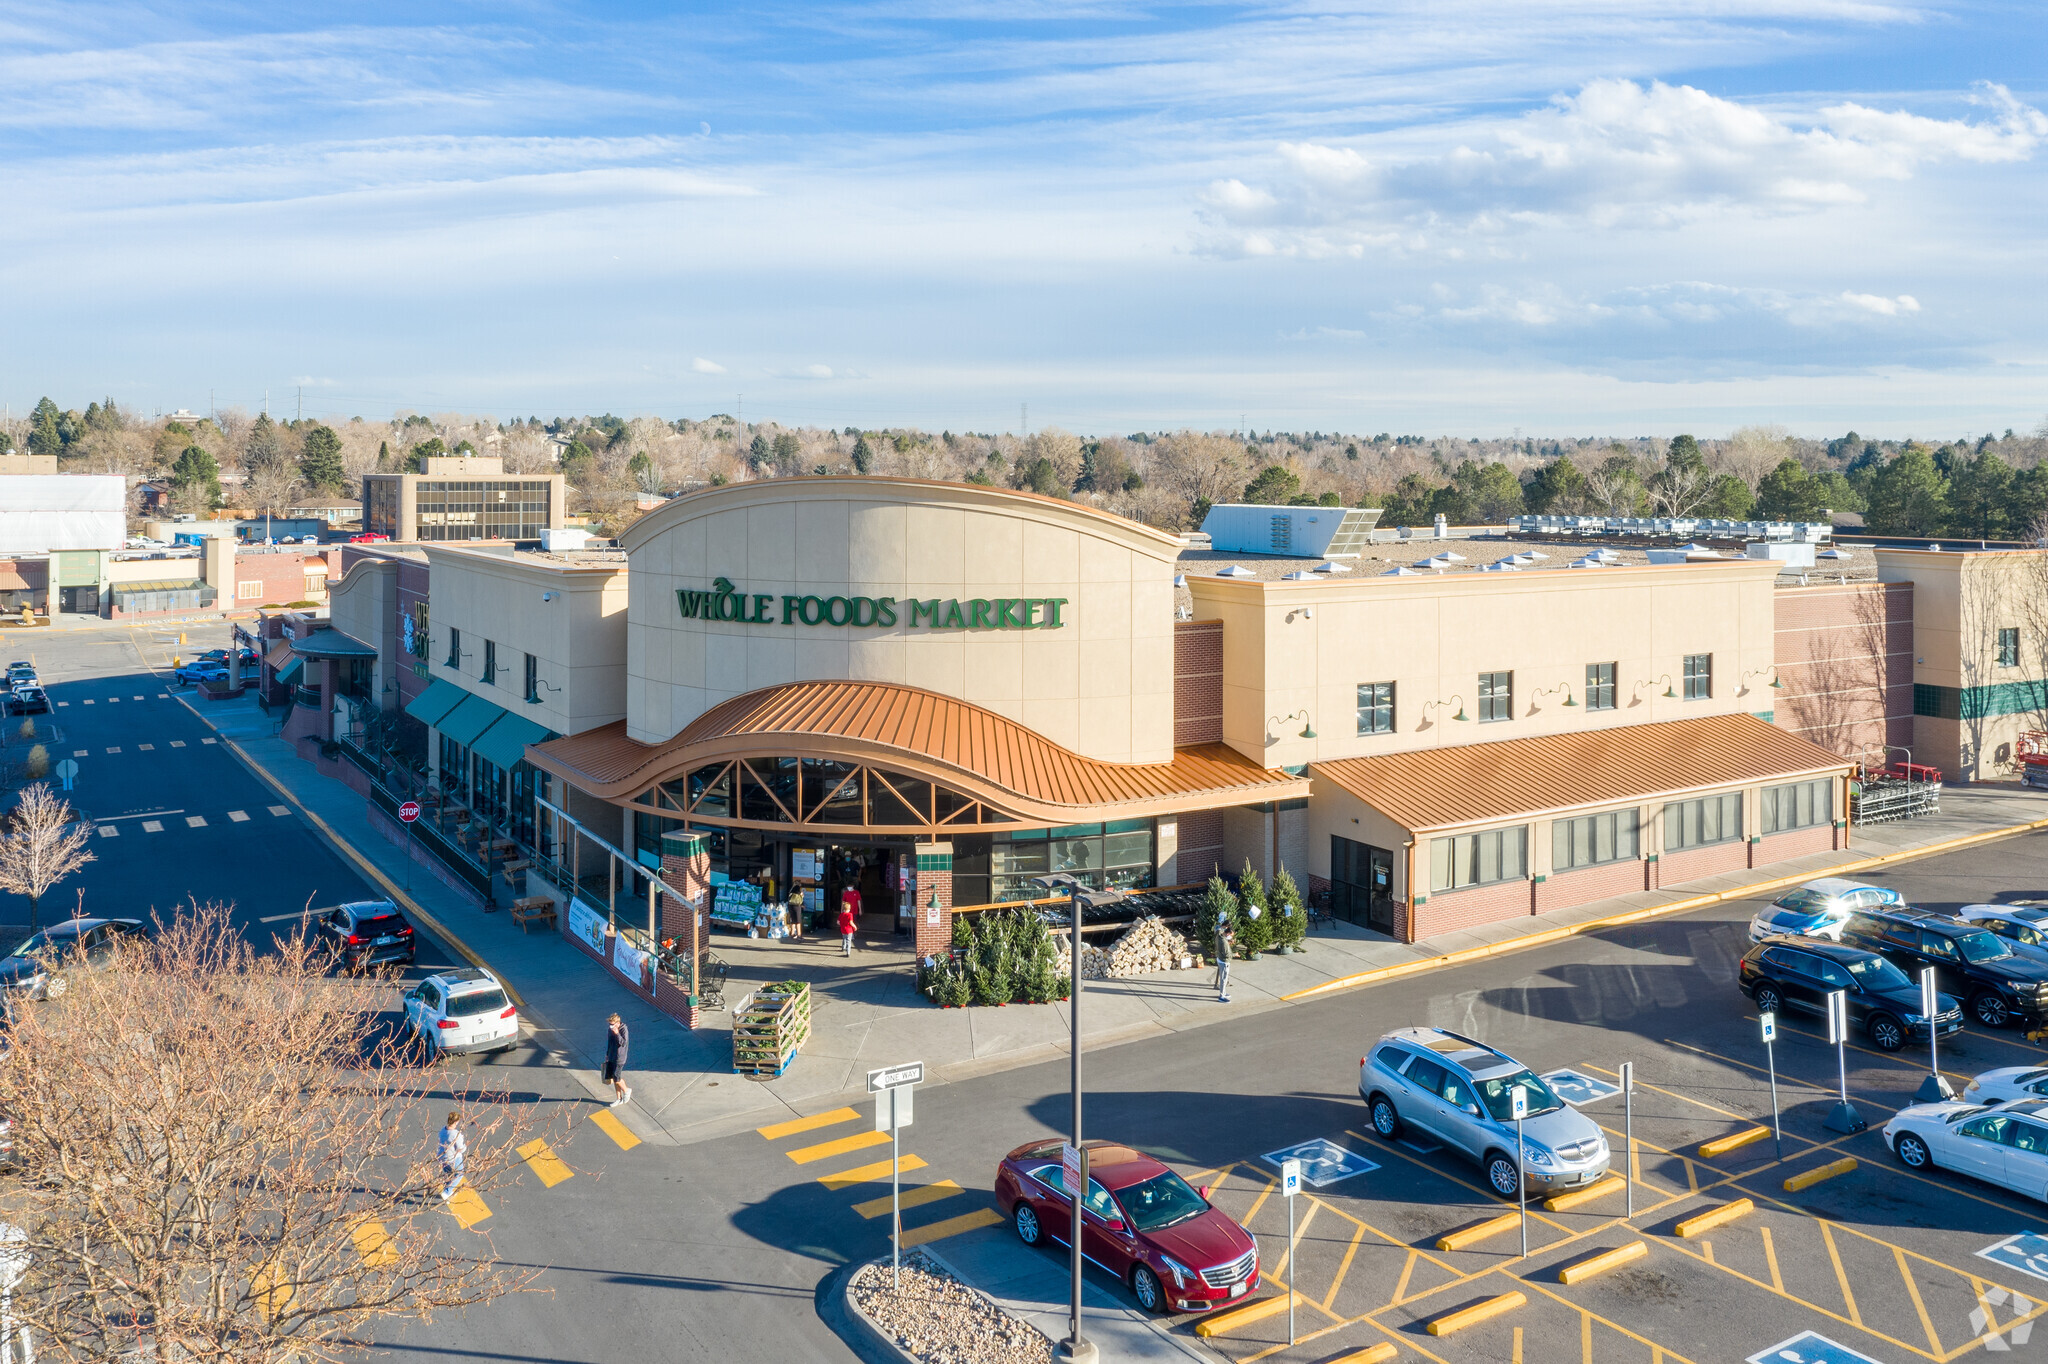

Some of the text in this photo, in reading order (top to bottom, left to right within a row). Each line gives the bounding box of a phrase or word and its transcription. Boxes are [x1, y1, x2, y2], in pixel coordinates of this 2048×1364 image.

[675, 589, 1069, 629] WHOLE FOODS MARKET
[400, 807, 419, 817] STOP
[885, 1069, 918, 1084] ONE WAY
